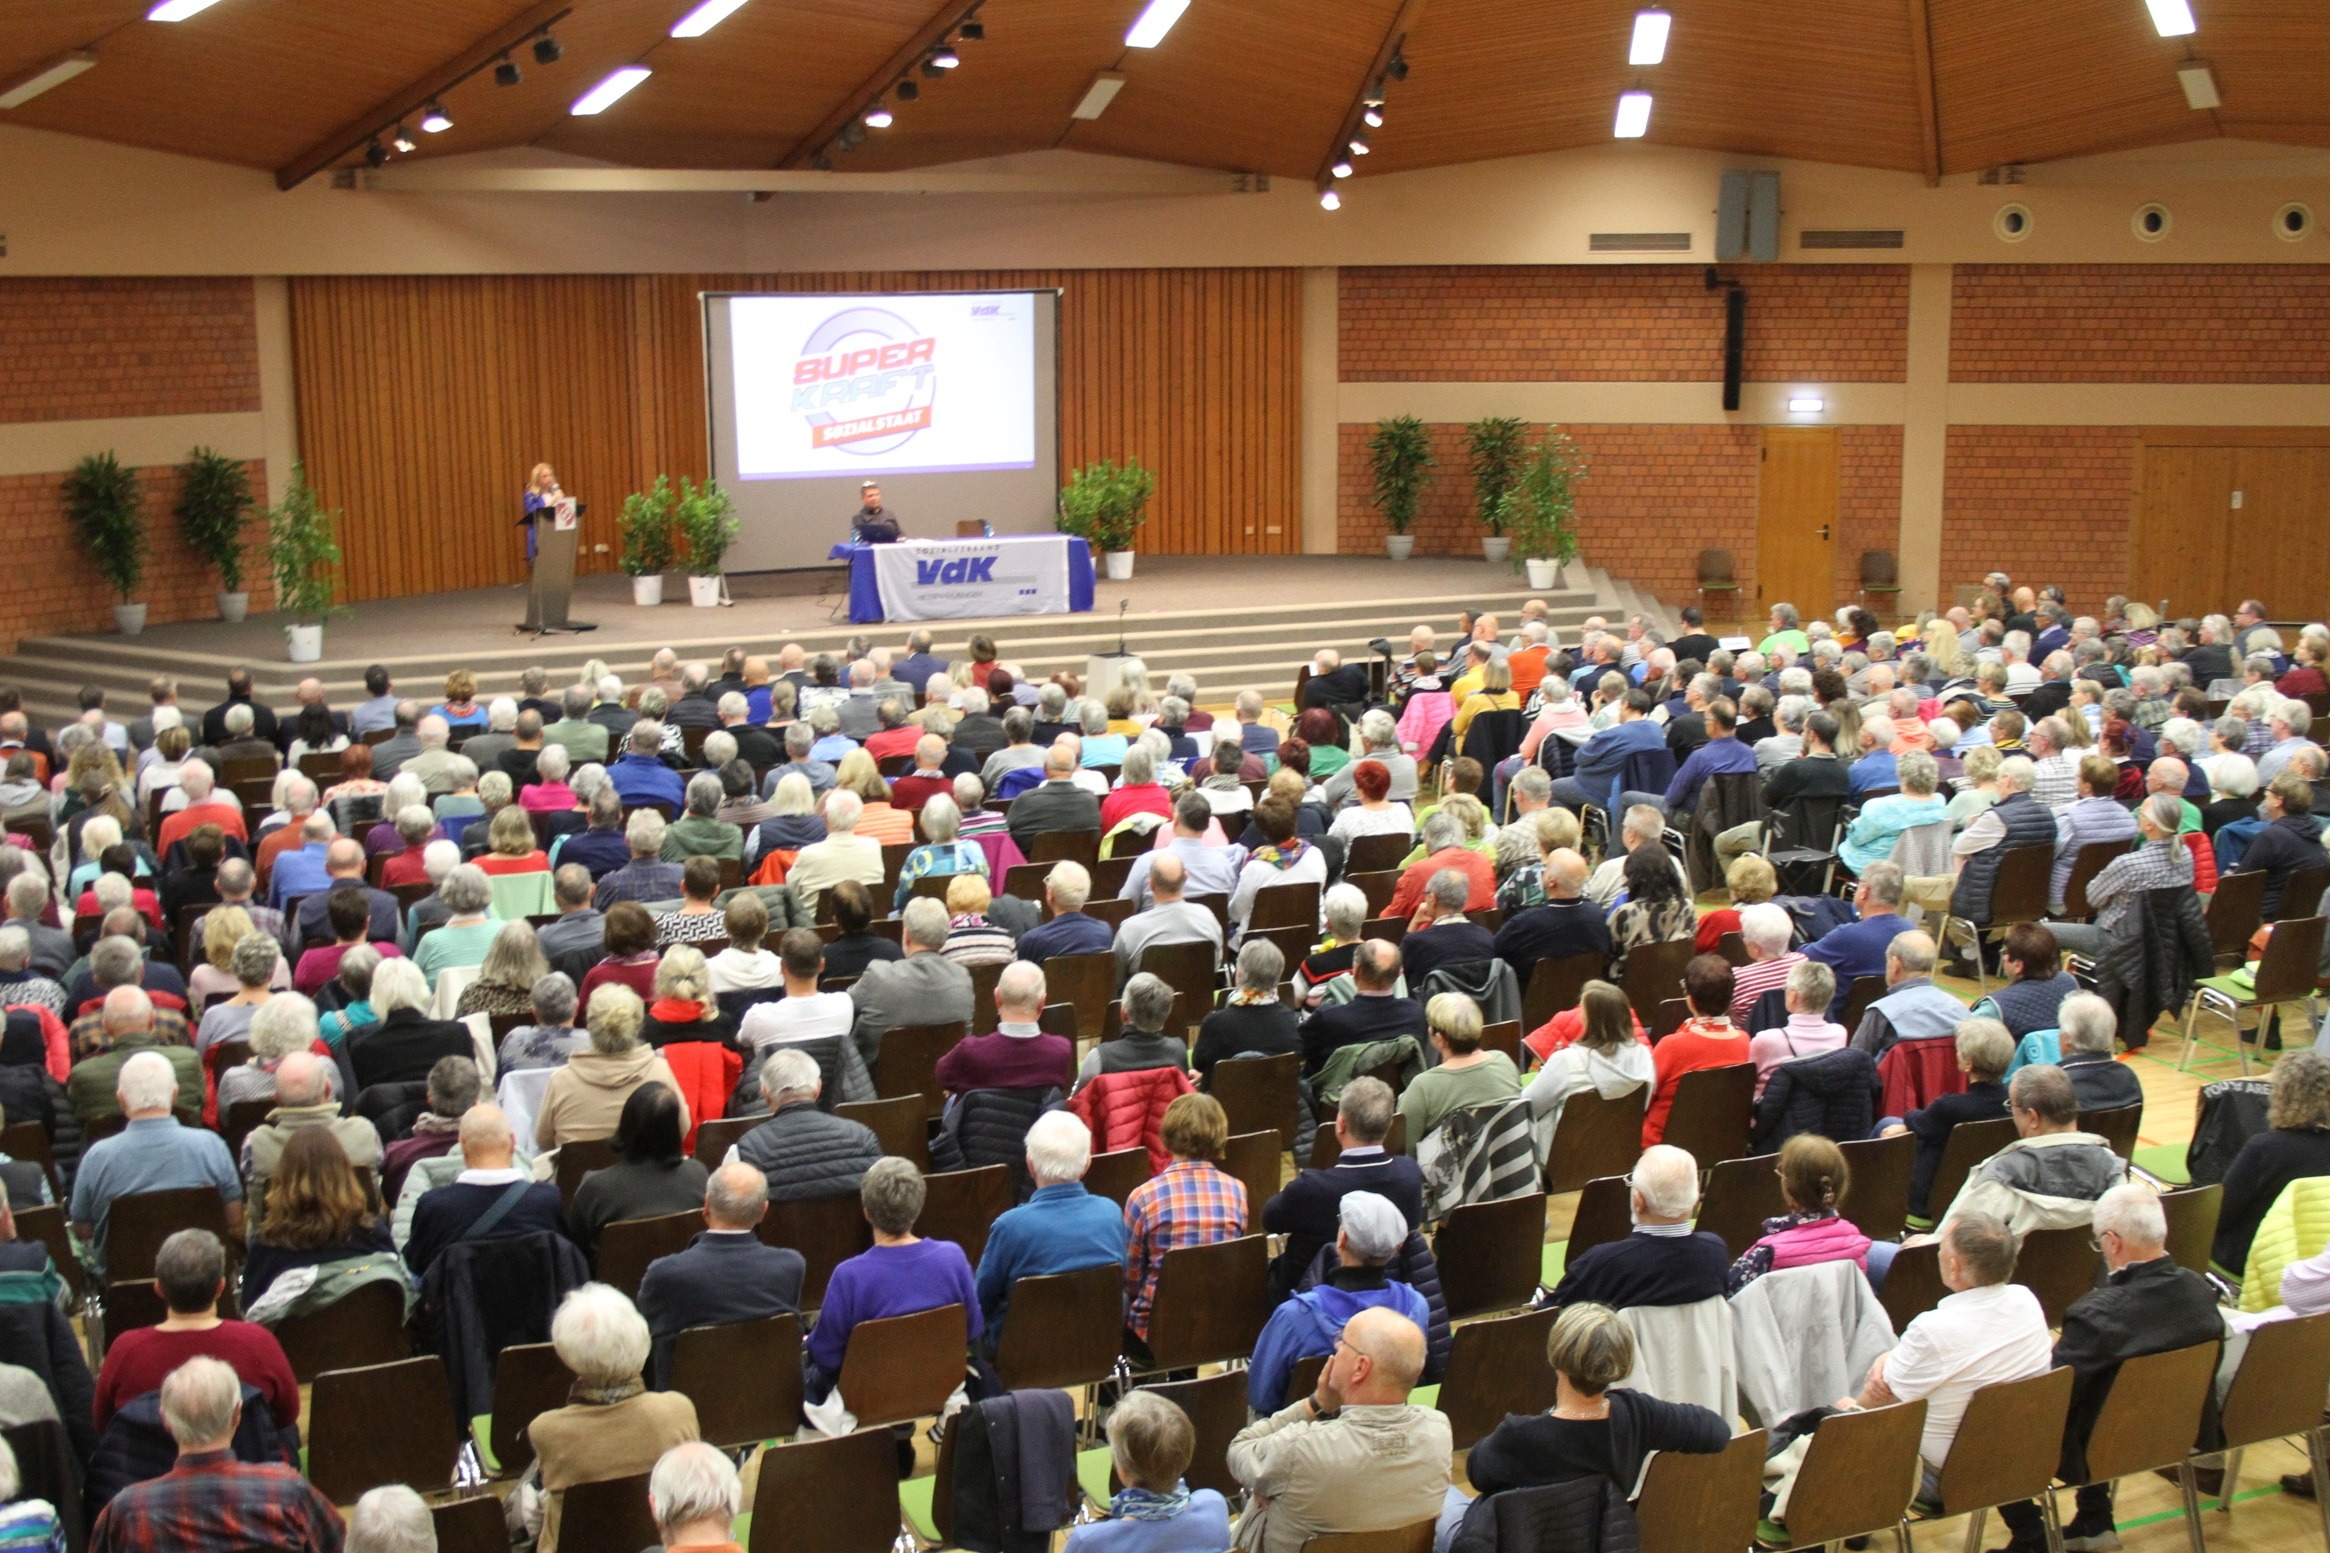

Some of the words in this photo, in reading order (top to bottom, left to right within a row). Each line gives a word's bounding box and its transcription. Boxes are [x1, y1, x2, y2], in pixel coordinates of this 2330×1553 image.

[971, 305, 1001, 316] VdK
[793, 338, 935, 384] SUPER
[791, 364, 934, 412] KRAFT
[823, 411, 922, 440] SOZIALSTAAT
[917, 557, 998, 585] VdK
